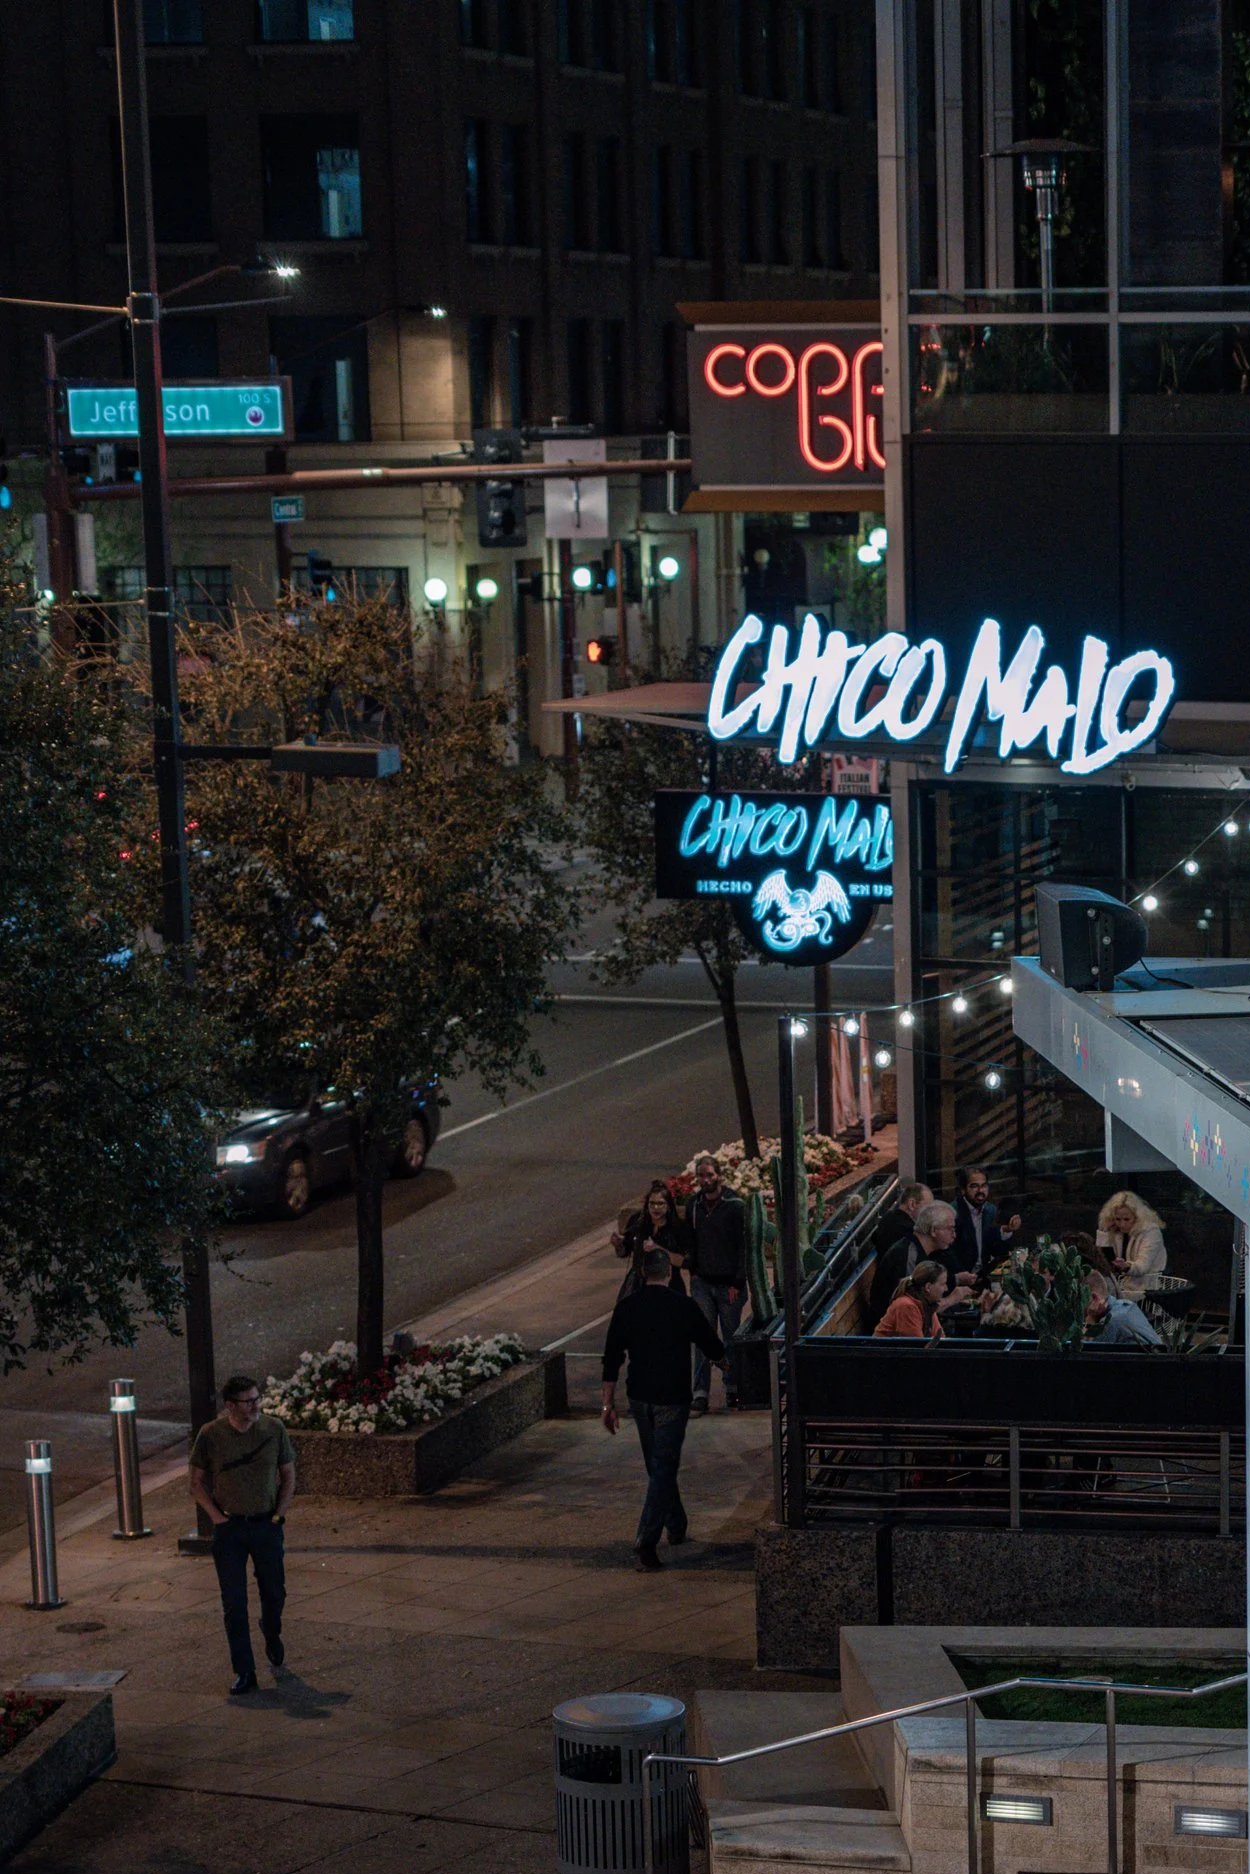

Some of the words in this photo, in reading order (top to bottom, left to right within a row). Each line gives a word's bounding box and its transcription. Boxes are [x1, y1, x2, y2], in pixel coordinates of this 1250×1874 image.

[238, 393, 259, 404] 100
[90, 401, 210, 422] Jeffson
[708, 613, 946, 764] CHICO
[840, 773, 869, 783] ITALIAN
[679, 794, 808, 868] CHICO
[696, 880, 753, 894] HECHO
[848, 883, 870, 896] EN
